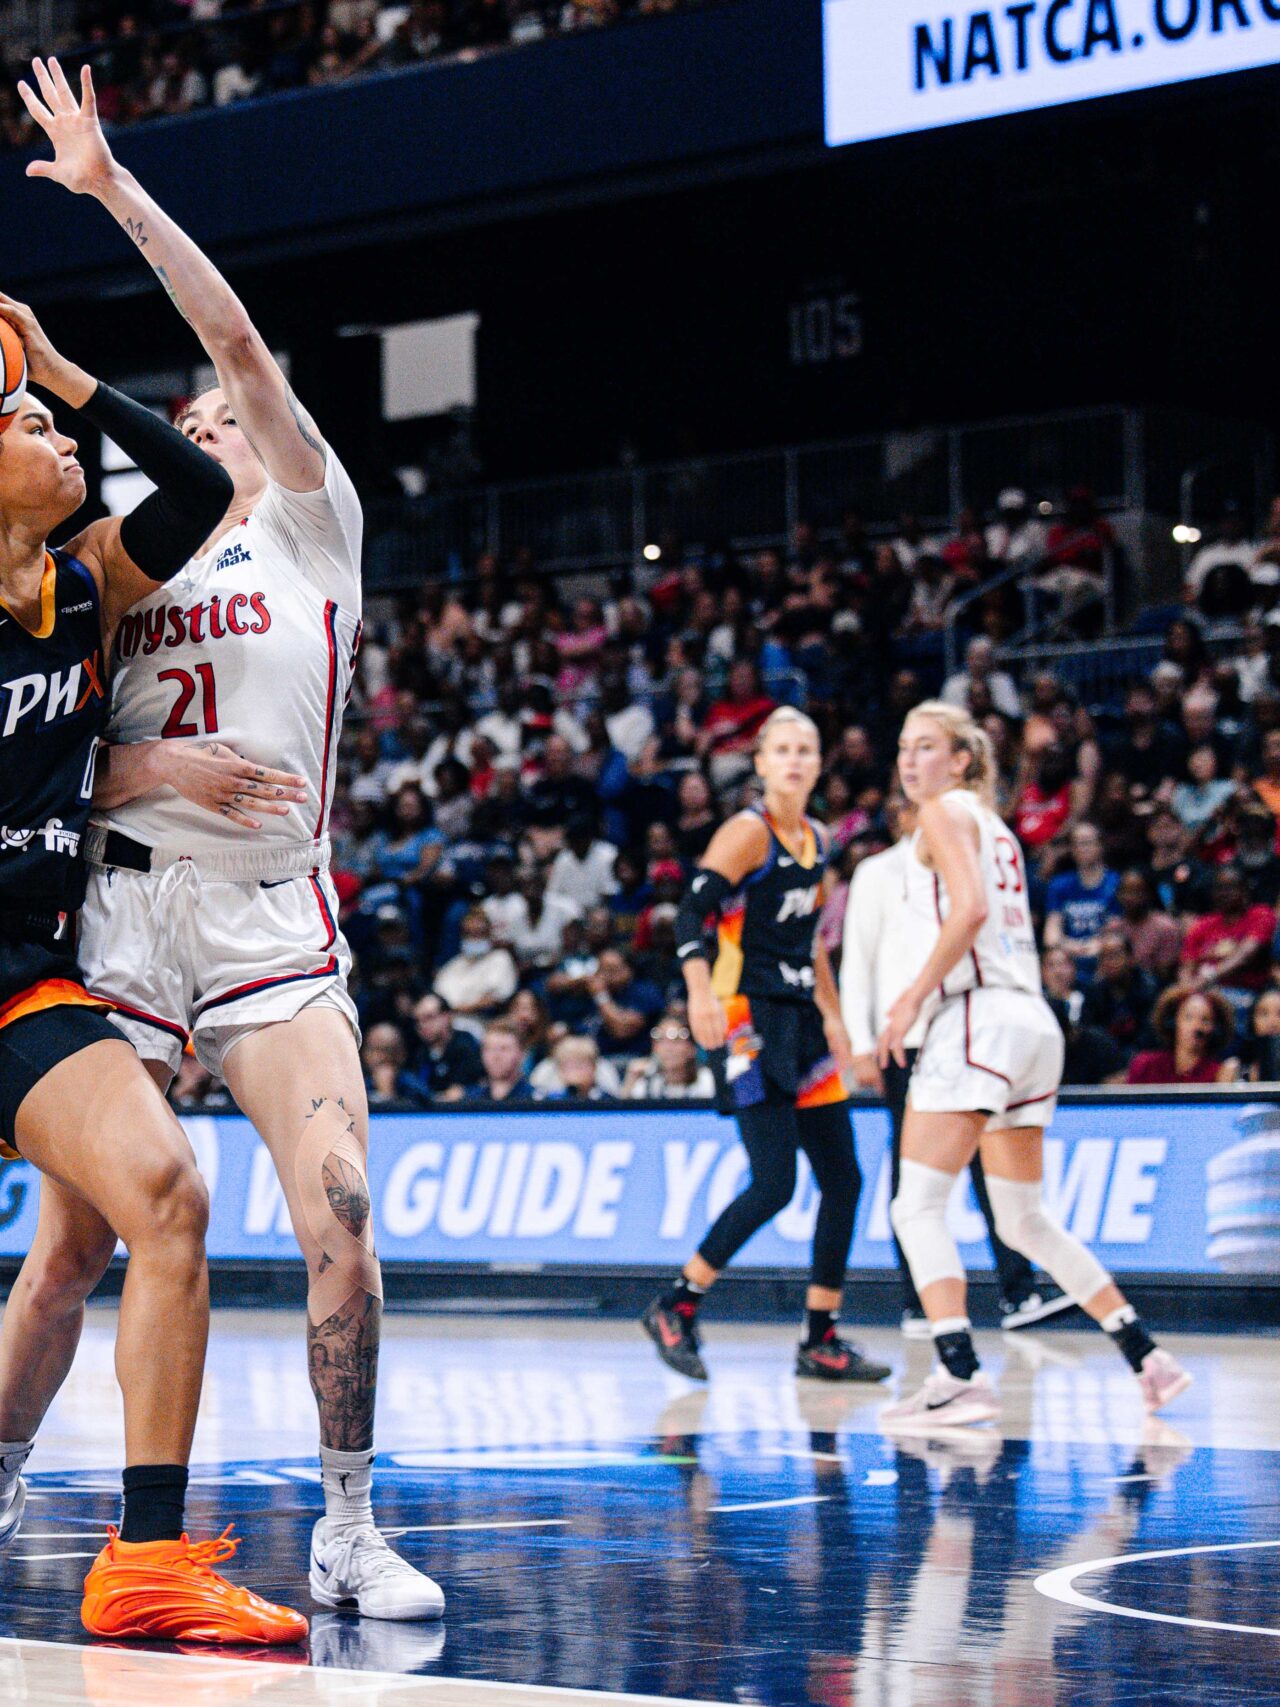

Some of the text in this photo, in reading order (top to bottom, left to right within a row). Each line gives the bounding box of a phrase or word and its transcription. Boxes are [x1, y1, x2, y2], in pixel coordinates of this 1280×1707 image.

[914, 0, 1280, 90] NATCA.OR
[787, 294, 863, 364] 105
[1, 650, 104, 737] PHX
[157, 662, 218, 739] 21
[382, 1142, 634, 1238] GUIDE
